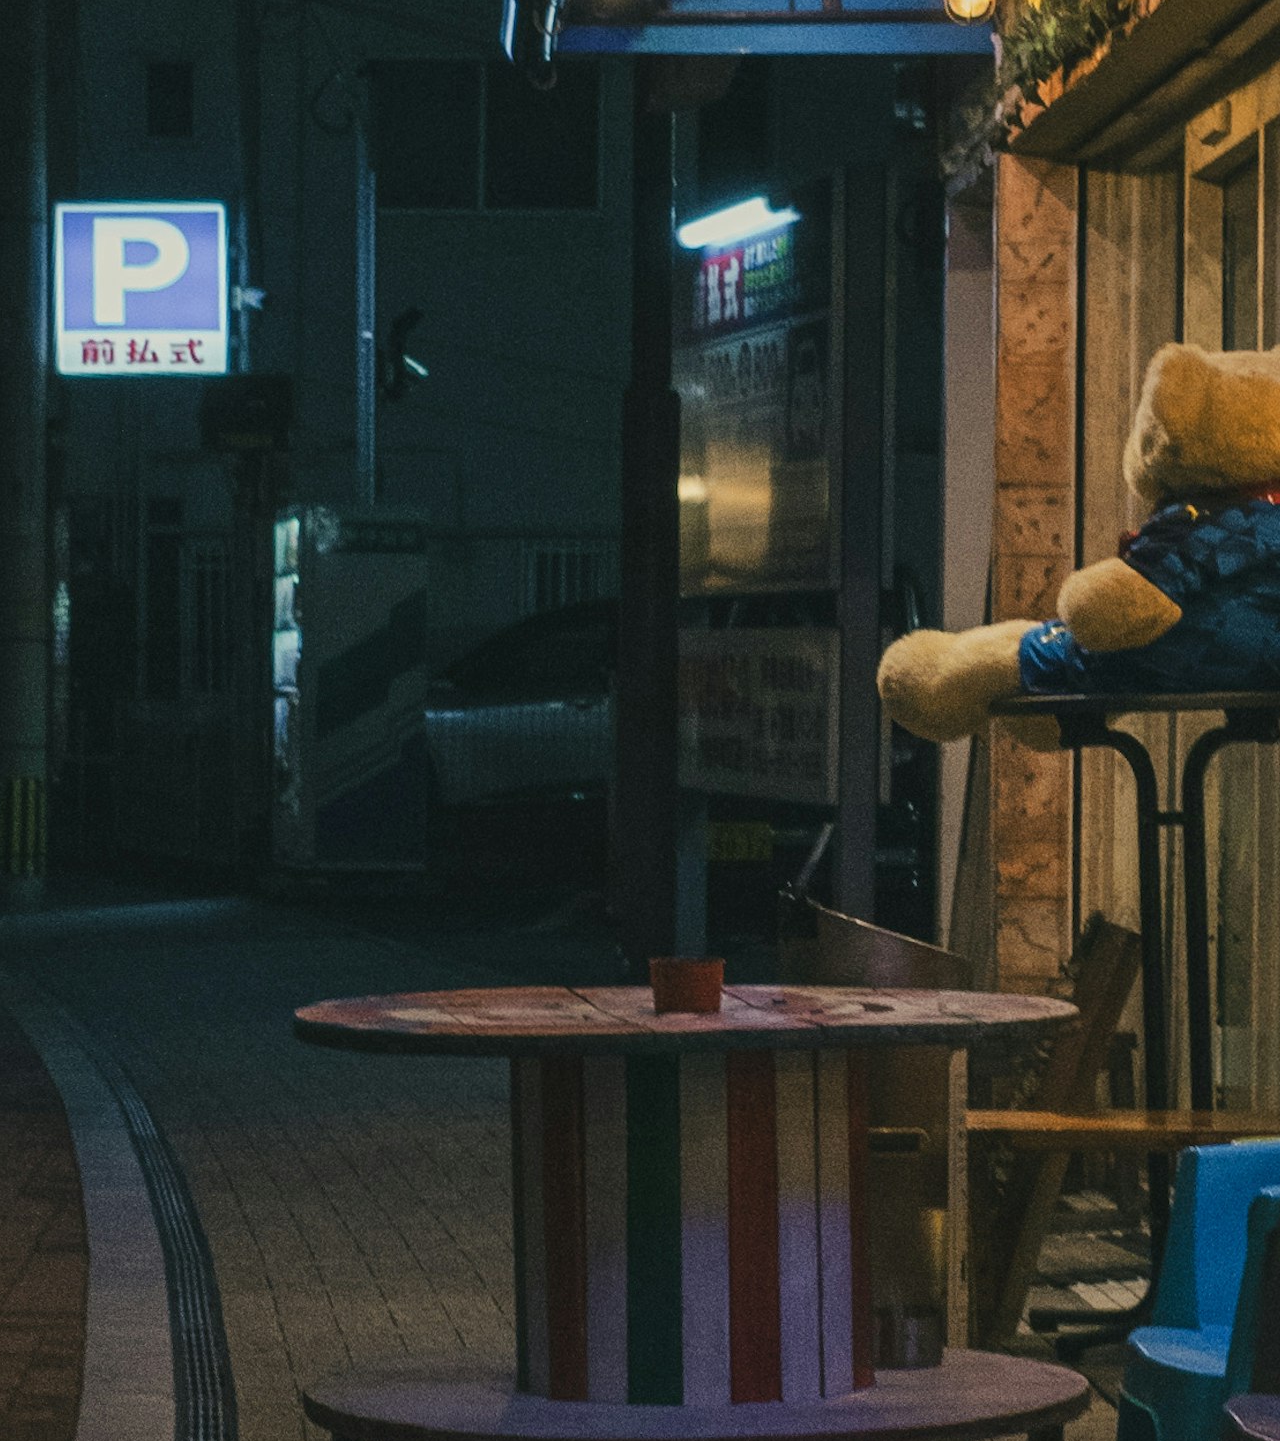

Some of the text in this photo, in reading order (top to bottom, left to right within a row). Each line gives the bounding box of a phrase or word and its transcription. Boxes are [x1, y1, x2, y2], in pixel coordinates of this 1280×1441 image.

[93, 217, 190, 326] P
[80, 338, 205, 365] 前払式
